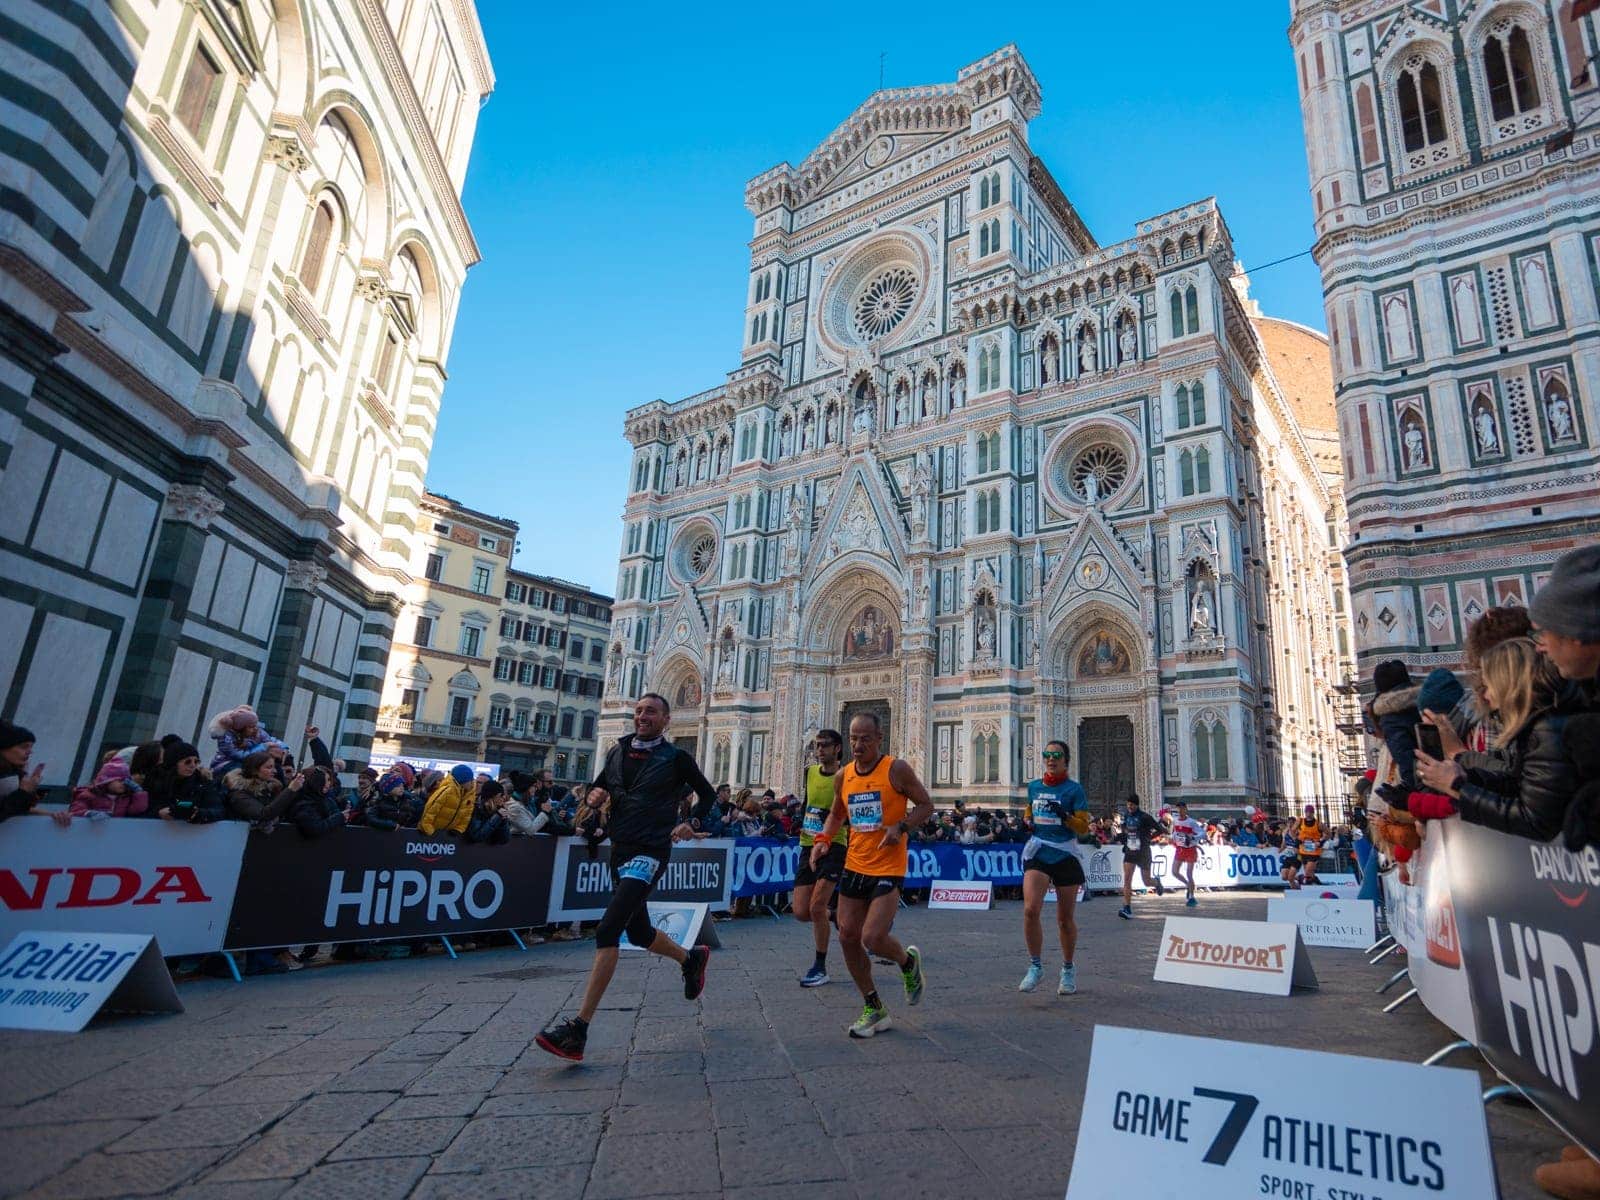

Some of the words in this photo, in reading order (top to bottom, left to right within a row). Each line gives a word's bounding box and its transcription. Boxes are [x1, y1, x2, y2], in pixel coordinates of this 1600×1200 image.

[855, 806, 874, 819] 6425
[576, 862, 613, 893] GAM
[657, 862, 719, 891] ATHLETICS
[323, 869, 504, 928] HiPRO
[0, 941, 137, 983] Cetilar
[1166, 933, 1286, 968] TUTTOSPORT
[11, 988, 90, 1013] moving
[1487, 916, 1600, 1100] HiP
[1112, 1090, 1192, 1144] GAME
[1193, 1086, 1260, 1167] 7
[1262, 1114, 1445, 1192] ATHLETICS
